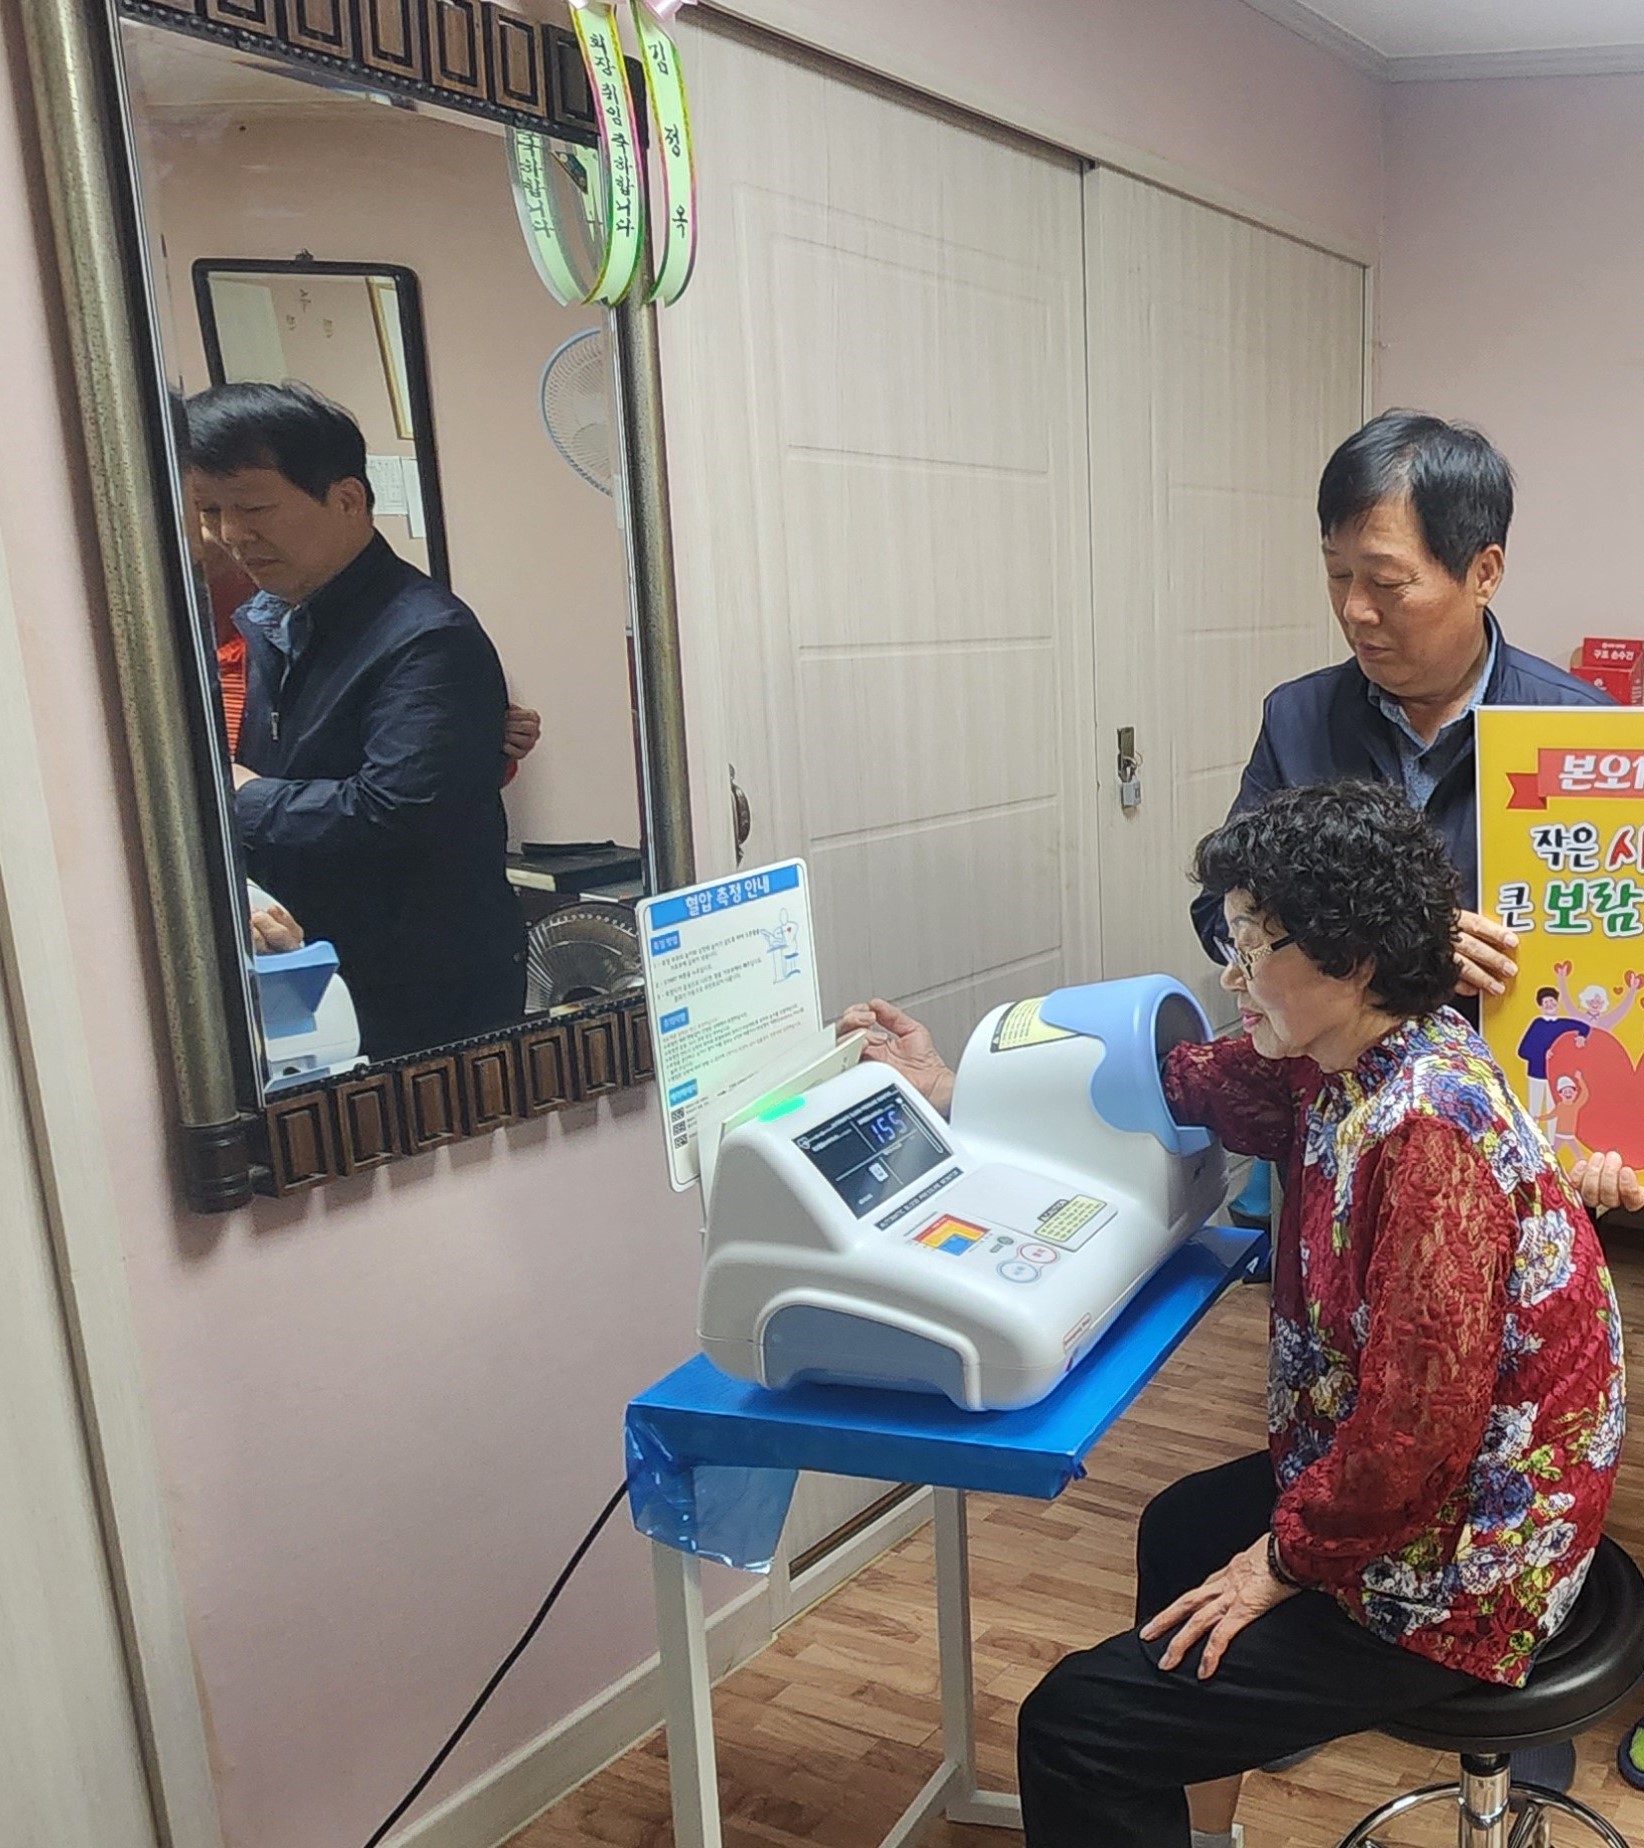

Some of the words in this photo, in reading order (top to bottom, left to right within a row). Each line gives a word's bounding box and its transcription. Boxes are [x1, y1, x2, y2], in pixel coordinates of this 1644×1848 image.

[647, 41, 669, 75] 김
[664, 123, 681, 157] 정
[671, 205, 689, 238] 옥
[1531, 824, 1599, 871] 작은
[684, 890, 712, 917] 혈압
[716, 881, 742, 907] 측정
[744, 874, 770, 899] 안내
[1498, 884, 1532, 930] 큰
[1545, 880, 1644, 934] 보람
